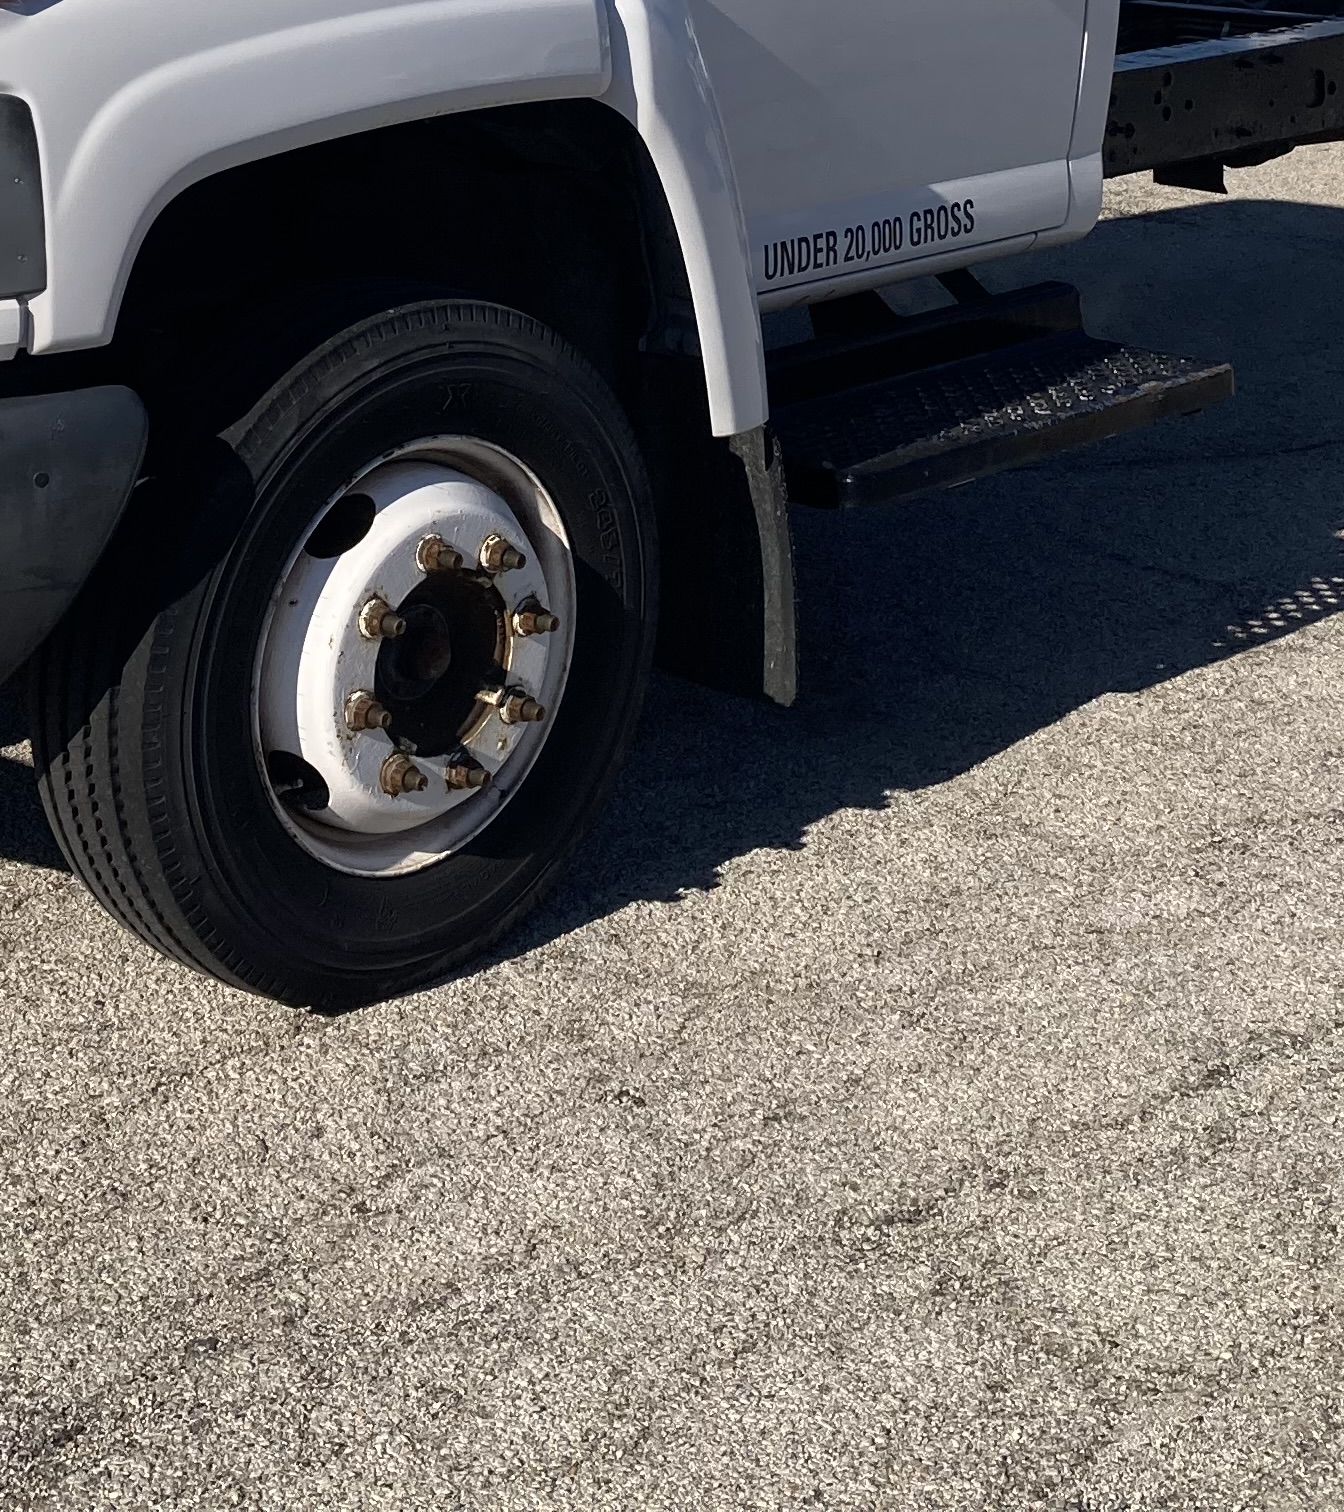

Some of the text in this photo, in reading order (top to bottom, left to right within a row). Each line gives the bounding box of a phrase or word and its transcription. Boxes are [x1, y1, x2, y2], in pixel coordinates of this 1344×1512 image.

[764, 199, 975, 280] UNDER 20,000 GROSS
